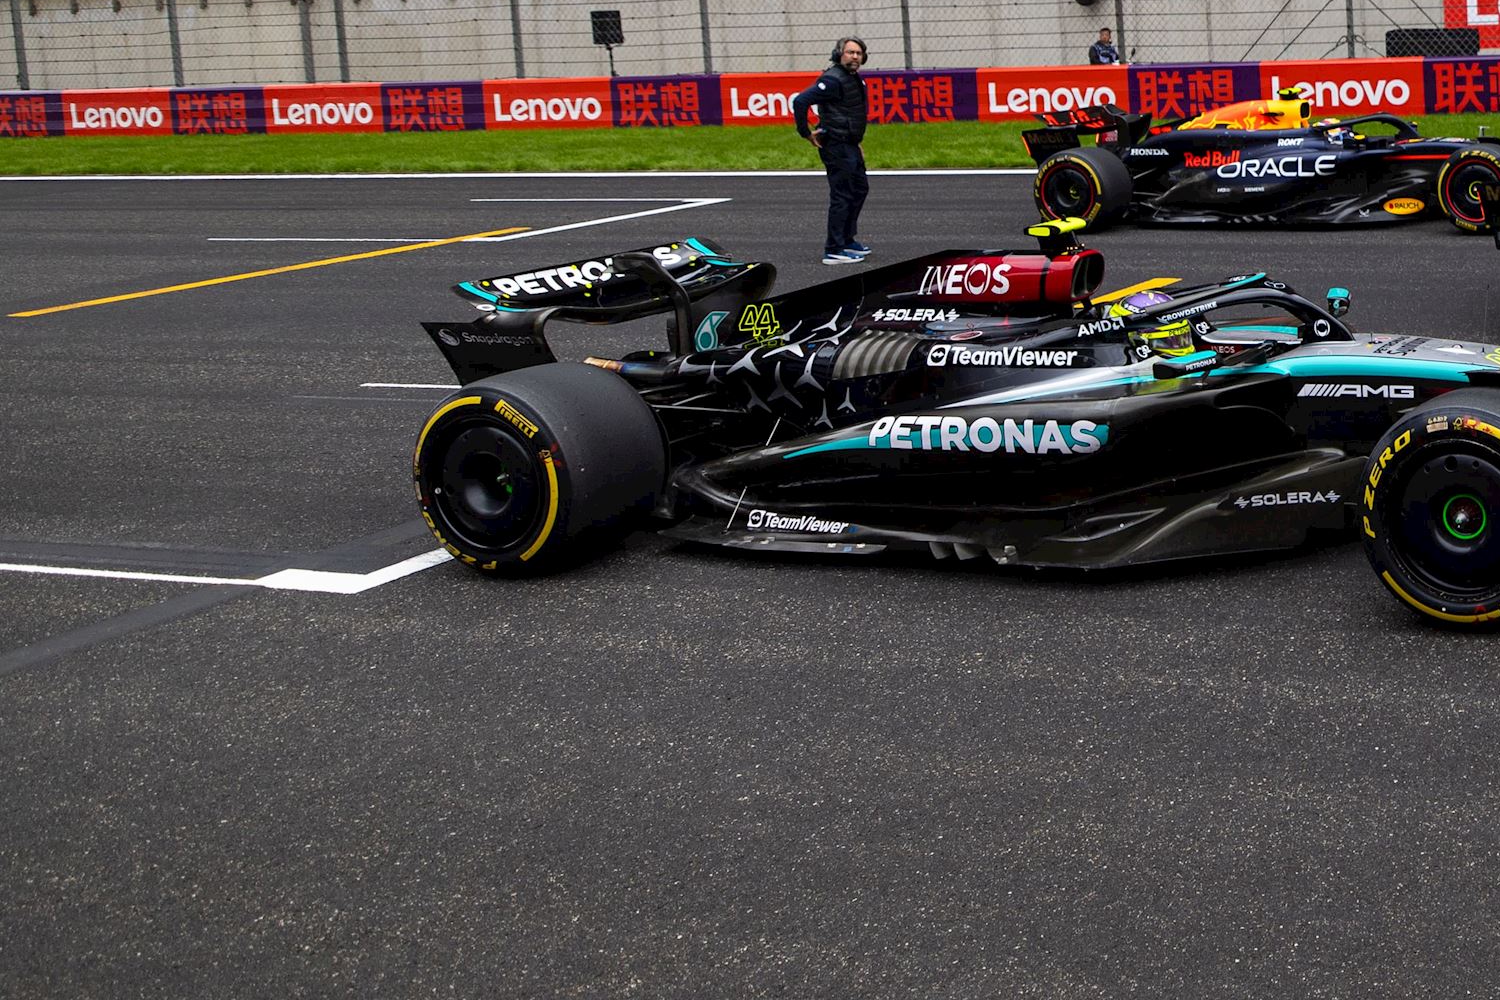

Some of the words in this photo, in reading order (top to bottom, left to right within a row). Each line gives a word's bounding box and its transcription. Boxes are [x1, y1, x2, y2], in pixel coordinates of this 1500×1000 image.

[618, 82, 700, 127] 联想
[866, 76, 954, 124] 联想
[989, 83, 1116, 112] Lenovo
[1137, 69, 1234, 118] 联想
[70, 103, 162, 129] Lenovo
[177, 93, 247, 135] 联想
[272, 99, 372, 125] Lenovo
[389, 87, 464, 131] 联想
[494, 94, 601, 122] Lenovo
[1277, 138, 1304, 147] ROKT
[1184, 150, 1211, 169] Red
[1212, 149, 1241, 167] Bull
[1217, 155, 1337, 178] ORACLE
[1394, 201, 1420, 210] RAUCH
[492, 246, 681, 298] PETROS
[917, 263, 1012, 296] INEOS
[738, 303, 780, 337] 44
[884, 308, 948, 322] SOLERA
[1161, 301, 1218, 323] CROWDSTRIKE
[461, 331, 534, 347] Snapdragon
[1077, 320, 1111, 338] AMD
[951, 346, 1078, 366] TeamViewer
[1185, 358, 1217, 371] PETRONAS
[1333, 383, 1415, 399] AMG
[494, 399, 539, 439] PIRELLI
[868, 415, 1102, 455] PETRONAS
[1364, 429, 1412, 511] ZERO
[1251, 491, 1327, 507] SOLERA
[764, 511, 849, 535] TeamViewer
[1363, 516, 1376, 538] P
